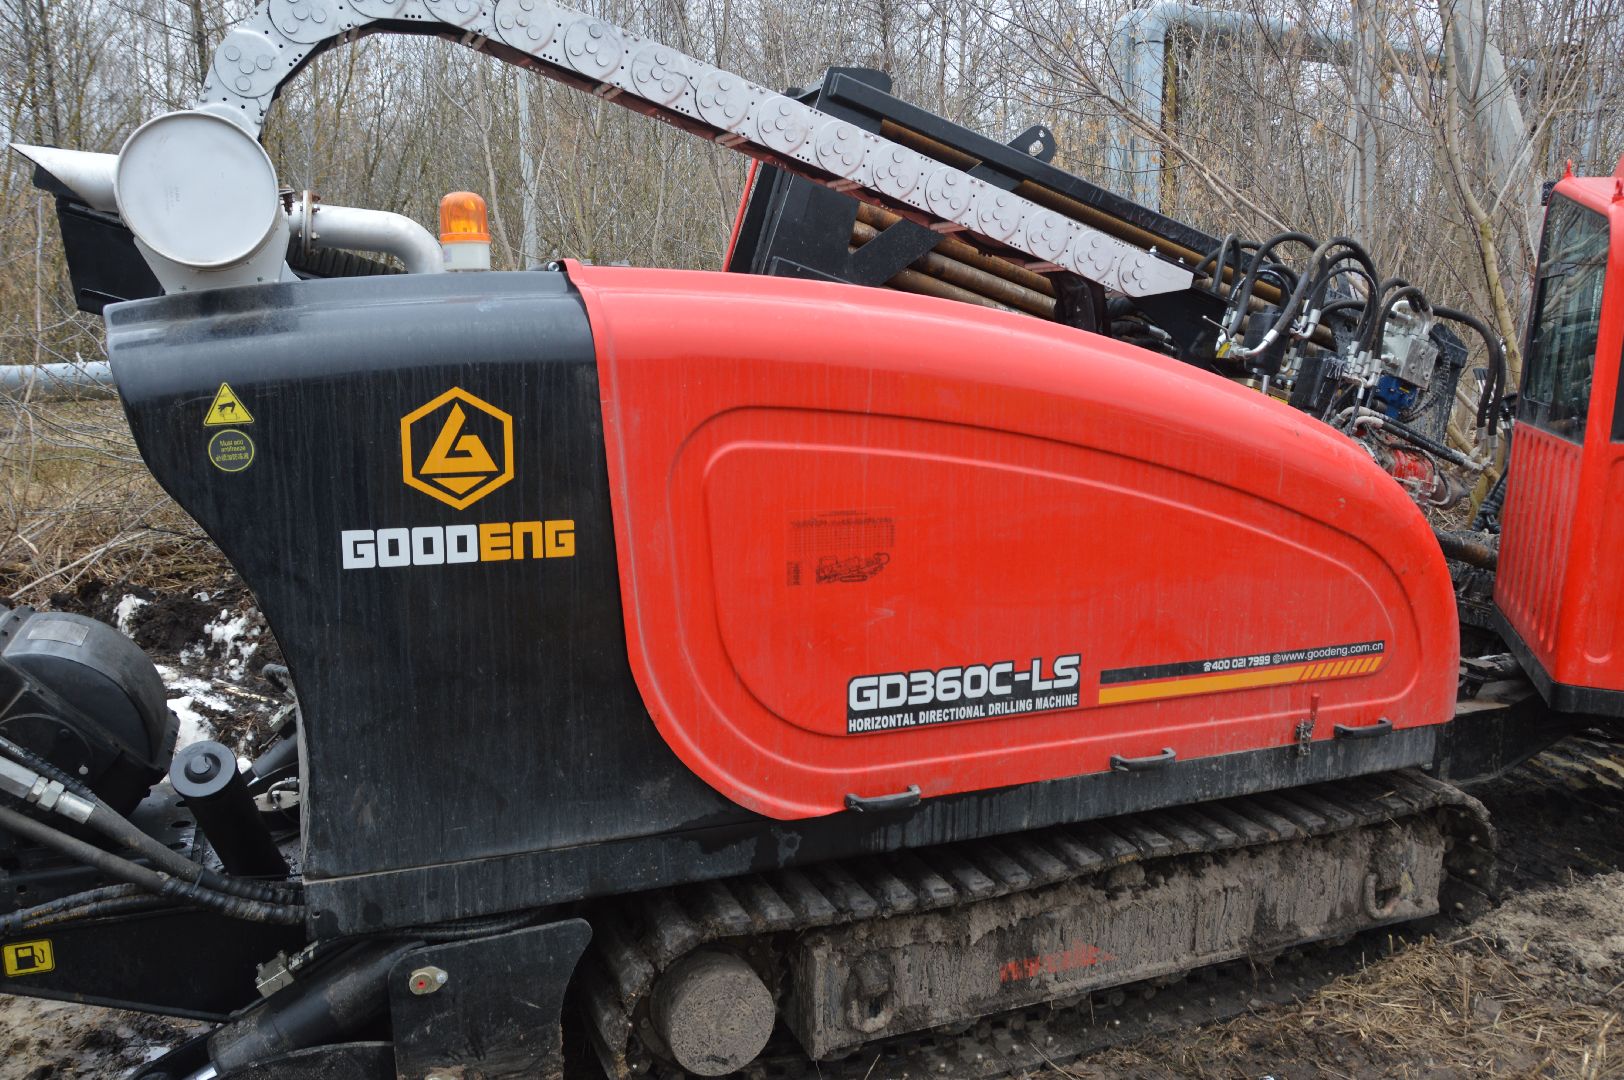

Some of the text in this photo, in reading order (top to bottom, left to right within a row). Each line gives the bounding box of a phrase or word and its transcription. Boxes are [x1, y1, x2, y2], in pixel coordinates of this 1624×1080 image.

[1211, 641, 1383, 670] 400 021 7999 www.goodeng.com.cn
[849, 655, 1080, 711] GD360C-LS
[848, 693, 1078, 732] HORIZONTAL DIRECTIONAL DRILLING MACHINE
